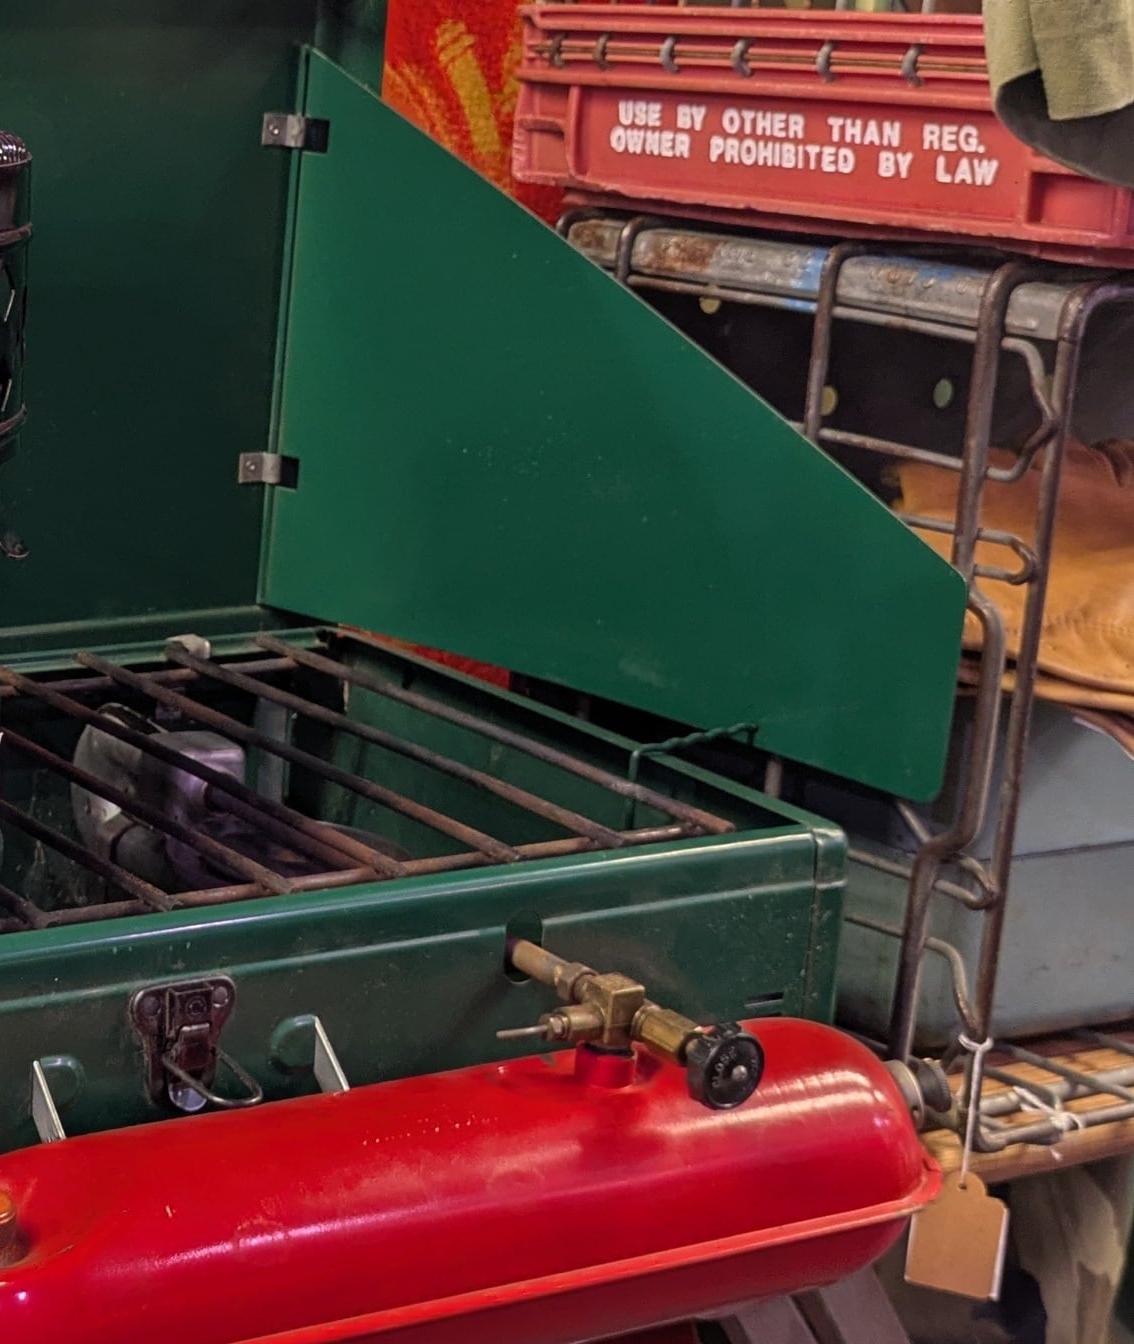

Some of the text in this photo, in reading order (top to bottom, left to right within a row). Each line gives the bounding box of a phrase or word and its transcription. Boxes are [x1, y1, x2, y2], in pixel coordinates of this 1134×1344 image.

[618, 99, 986, 155] USE BY OTHER THAN REG.
[610, 126, 999, 187] OWNER PROHIBITED BY LAW
